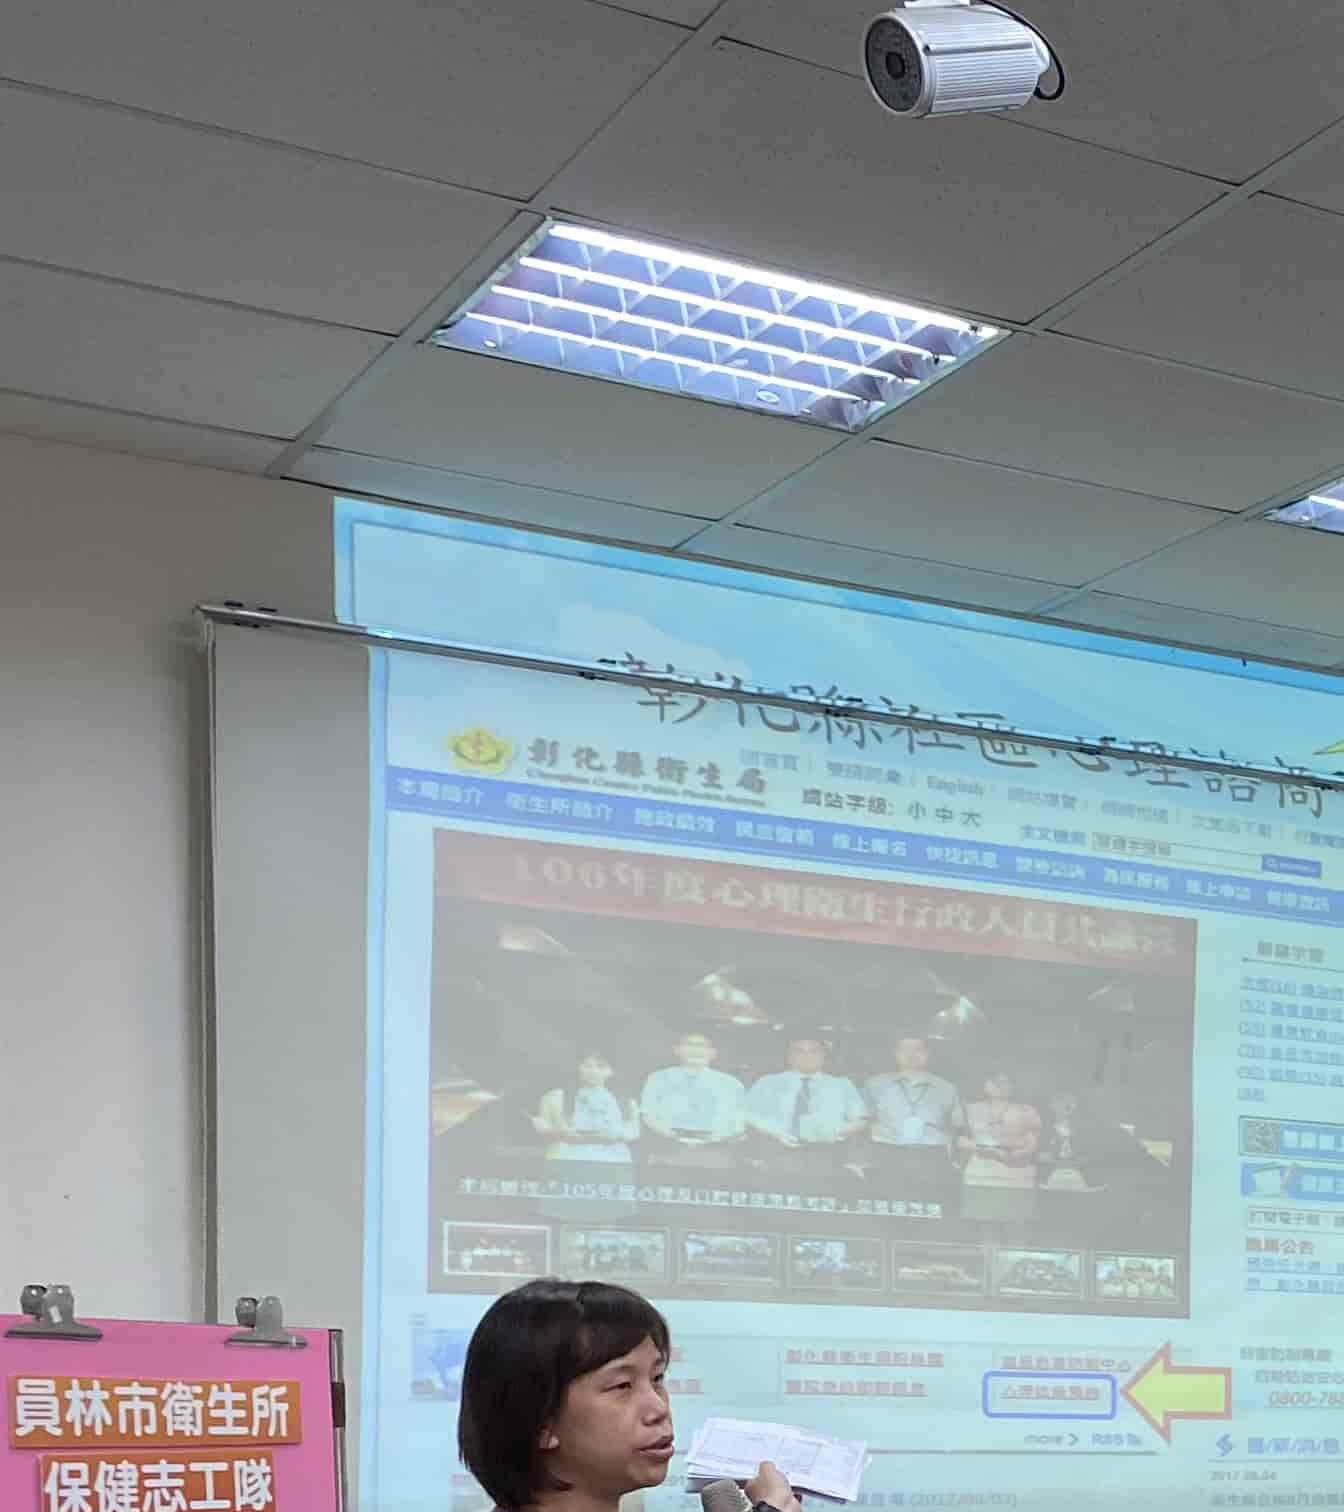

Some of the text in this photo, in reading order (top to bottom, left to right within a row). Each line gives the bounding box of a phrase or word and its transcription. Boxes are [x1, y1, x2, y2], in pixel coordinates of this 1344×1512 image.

[15, 1378, 290, 1440] 員林市衛生所
